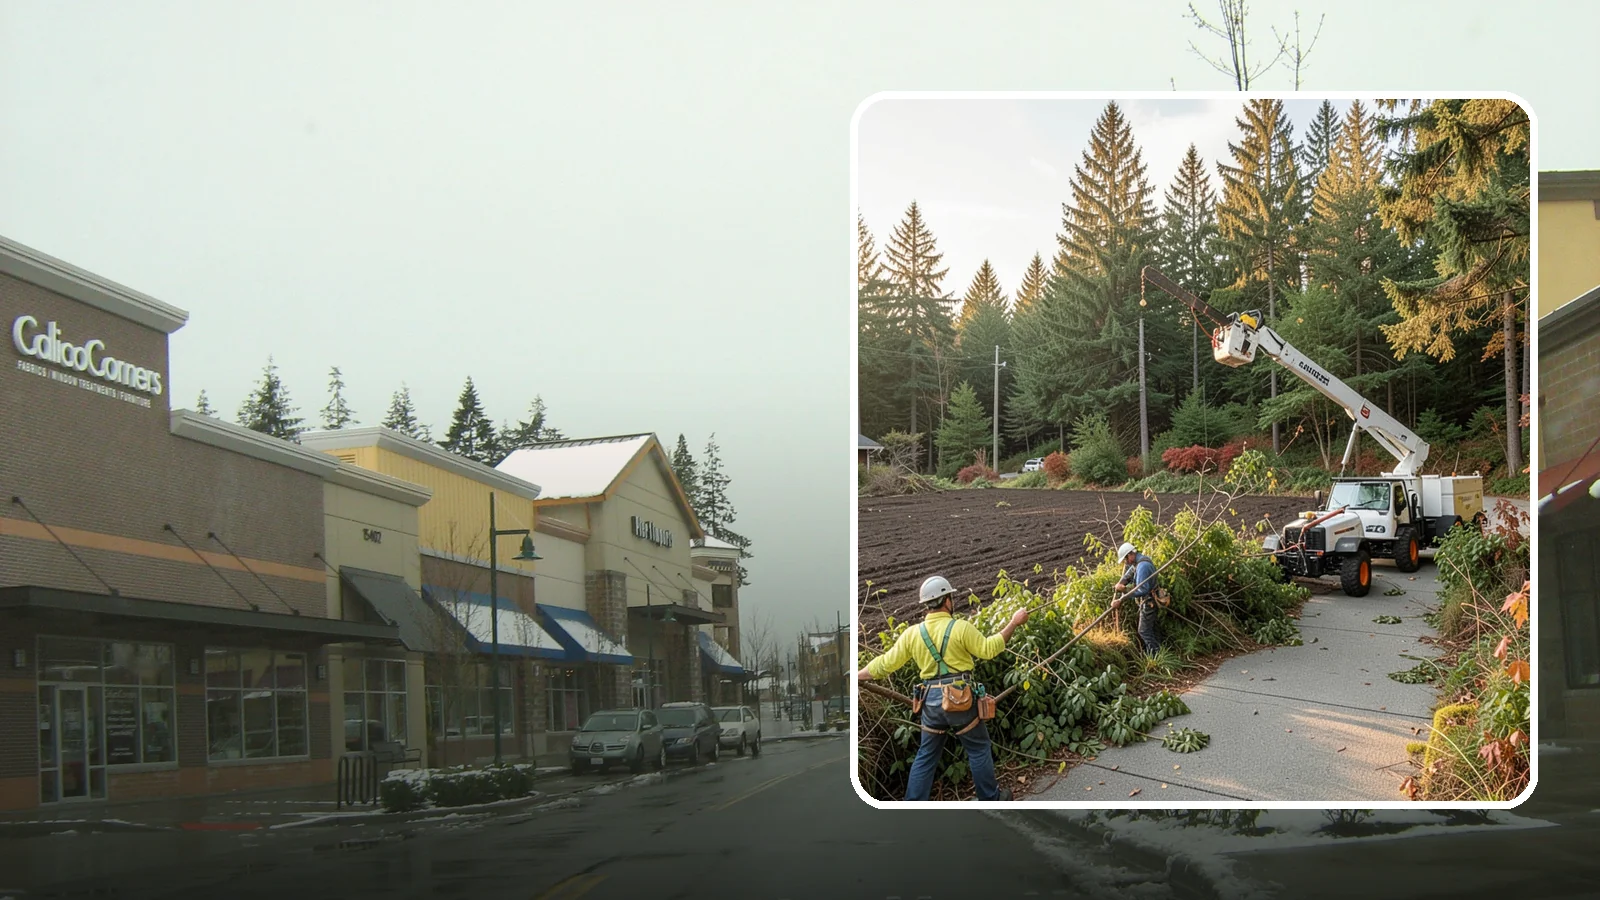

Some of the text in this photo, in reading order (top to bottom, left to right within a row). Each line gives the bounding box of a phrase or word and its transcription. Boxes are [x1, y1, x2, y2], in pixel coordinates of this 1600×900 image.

[16, 360, 151, 408] FABRICS WINDOW TREATMENTS FURNITURE
